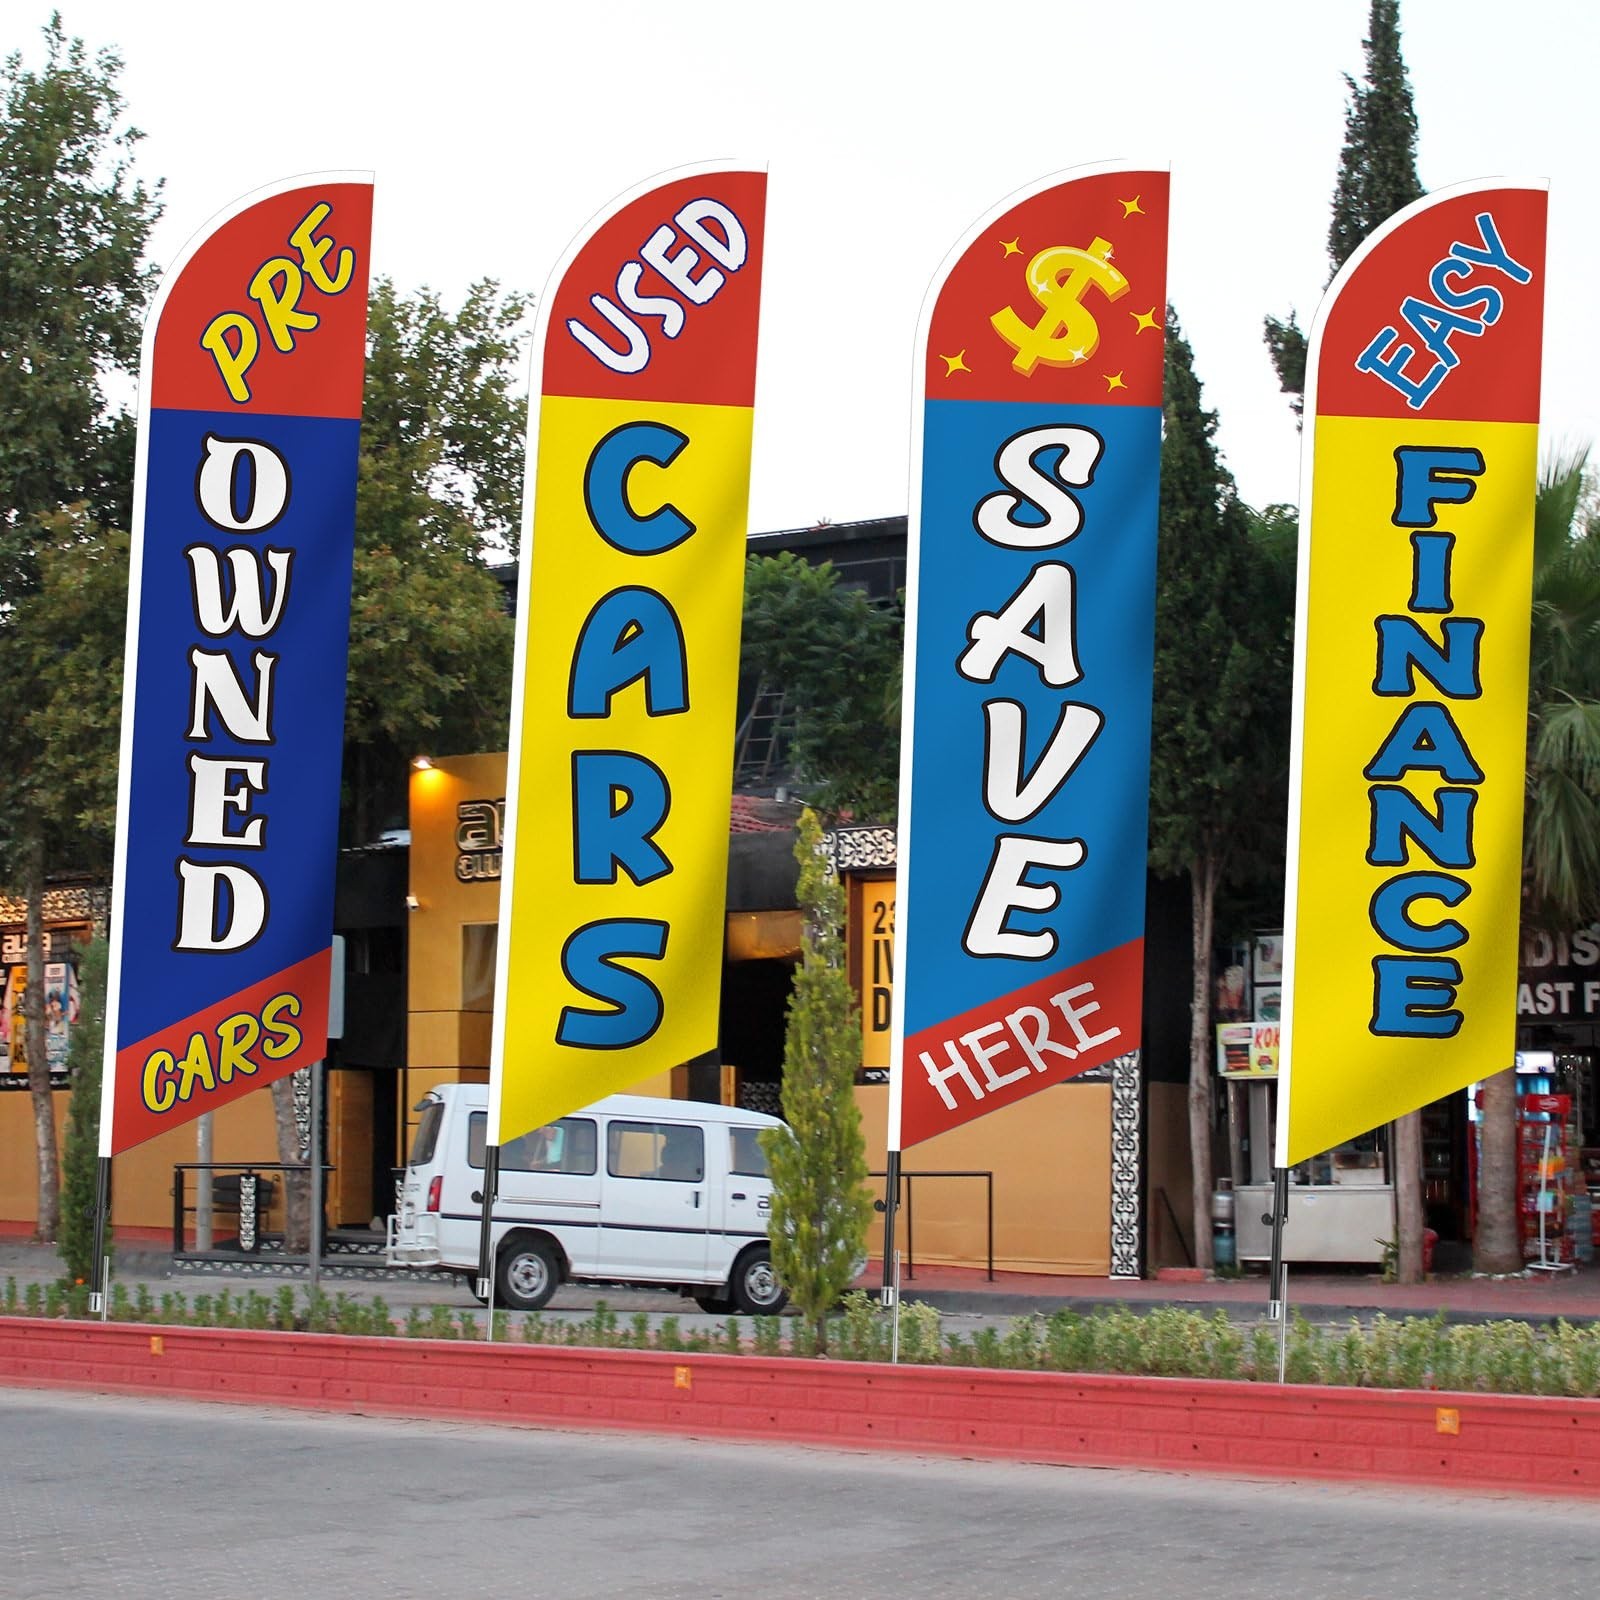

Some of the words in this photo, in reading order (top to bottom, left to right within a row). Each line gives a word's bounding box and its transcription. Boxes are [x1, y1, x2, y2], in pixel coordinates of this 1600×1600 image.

[202, 201, 355, 403] PRE
[567, 197, 750, 373] USED
[1354, 213, 1532, 411] EASY
[174, 433, 294, 952] OWNED
[557, 421, 697, 1048] CARS
[958, 423, 1106, 959] SAVE
[1364, 445, 1485, 1037] FINANCE
[141, 993, 304, 1113] CARS
[919, 981, 1121, 1111] HERE
[1517, 982, 1575, 1015] AST
